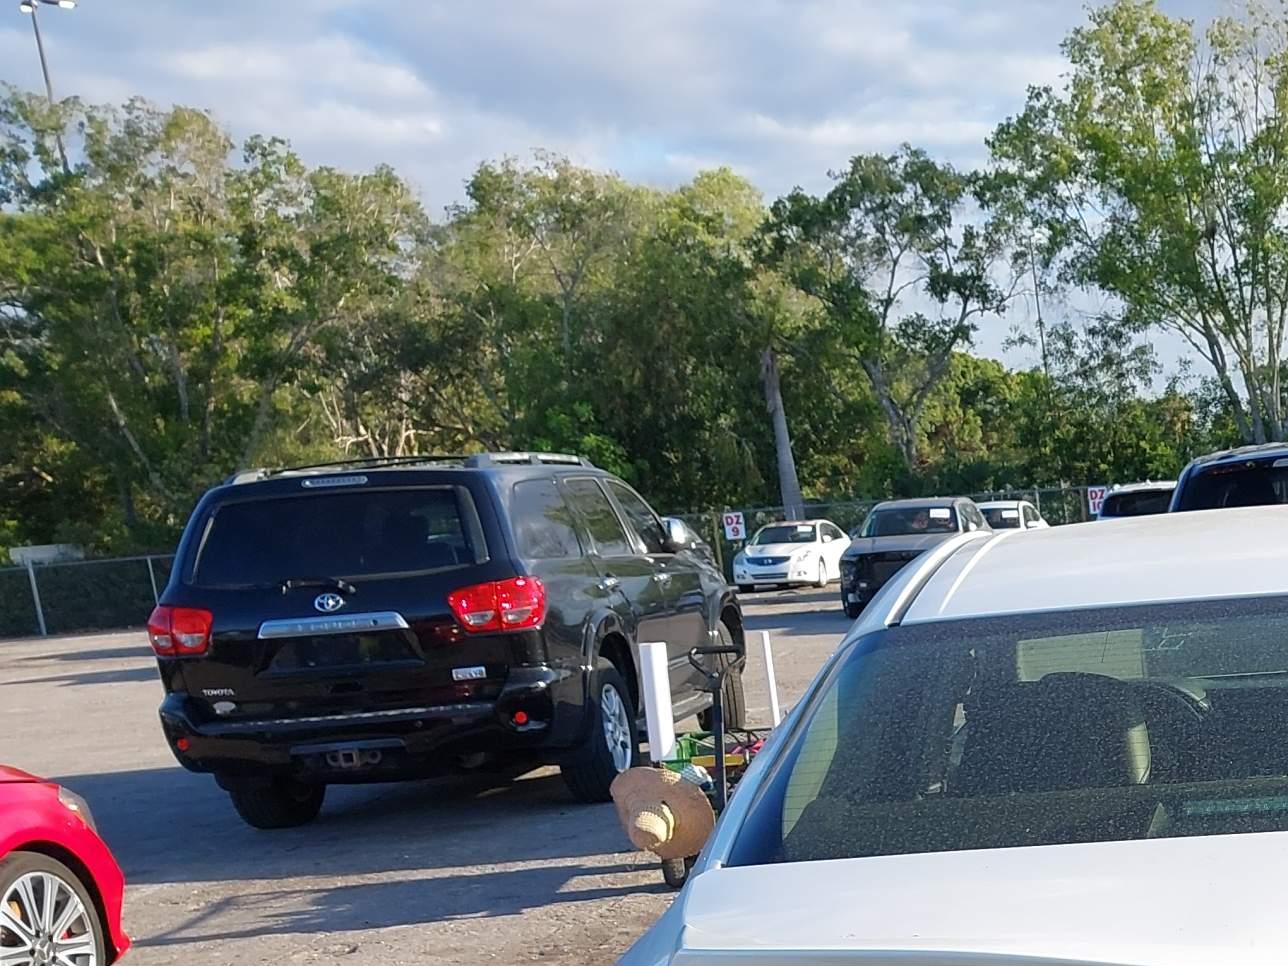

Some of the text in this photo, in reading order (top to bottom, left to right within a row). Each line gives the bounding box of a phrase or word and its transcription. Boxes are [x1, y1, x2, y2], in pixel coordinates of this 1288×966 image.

[1090, 489, 1104, 500] DZ
[725, 515, 742, 526] DZ
[732, 526, 740, 536] 9
